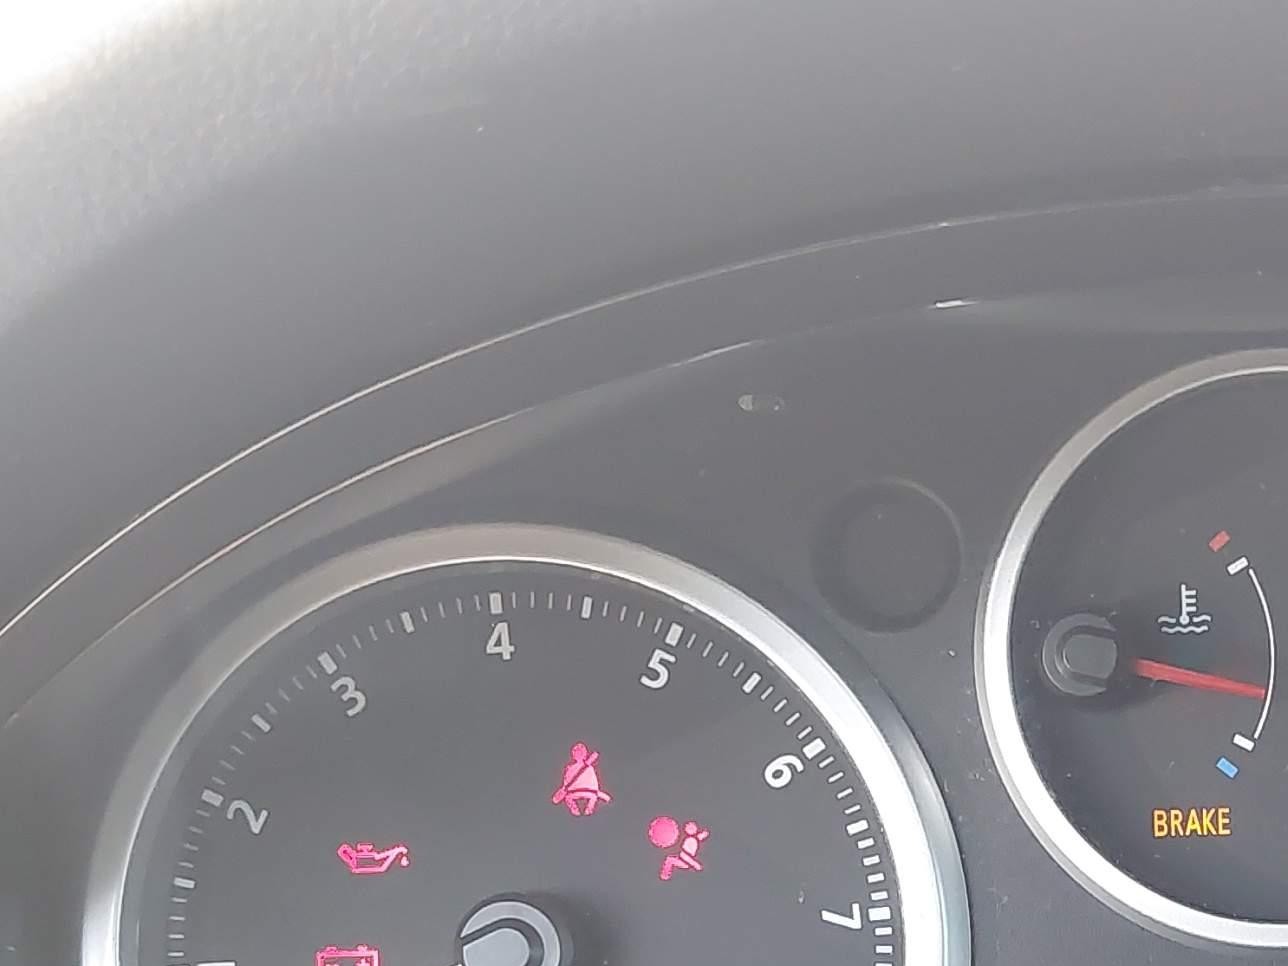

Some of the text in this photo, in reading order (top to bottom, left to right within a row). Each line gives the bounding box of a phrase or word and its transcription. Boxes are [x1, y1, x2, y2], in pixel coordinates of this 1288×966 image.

[486, 622, 515, 661] 4
[640, 648, 676, 689] 5
[330, 676, 366, 717] 3
[764, 753, 804, 788] 6
[226, 799, 268, 834] 2
[1153, 807, 1231, 837] BRAKE
[821, 903, 862, 930] 7
